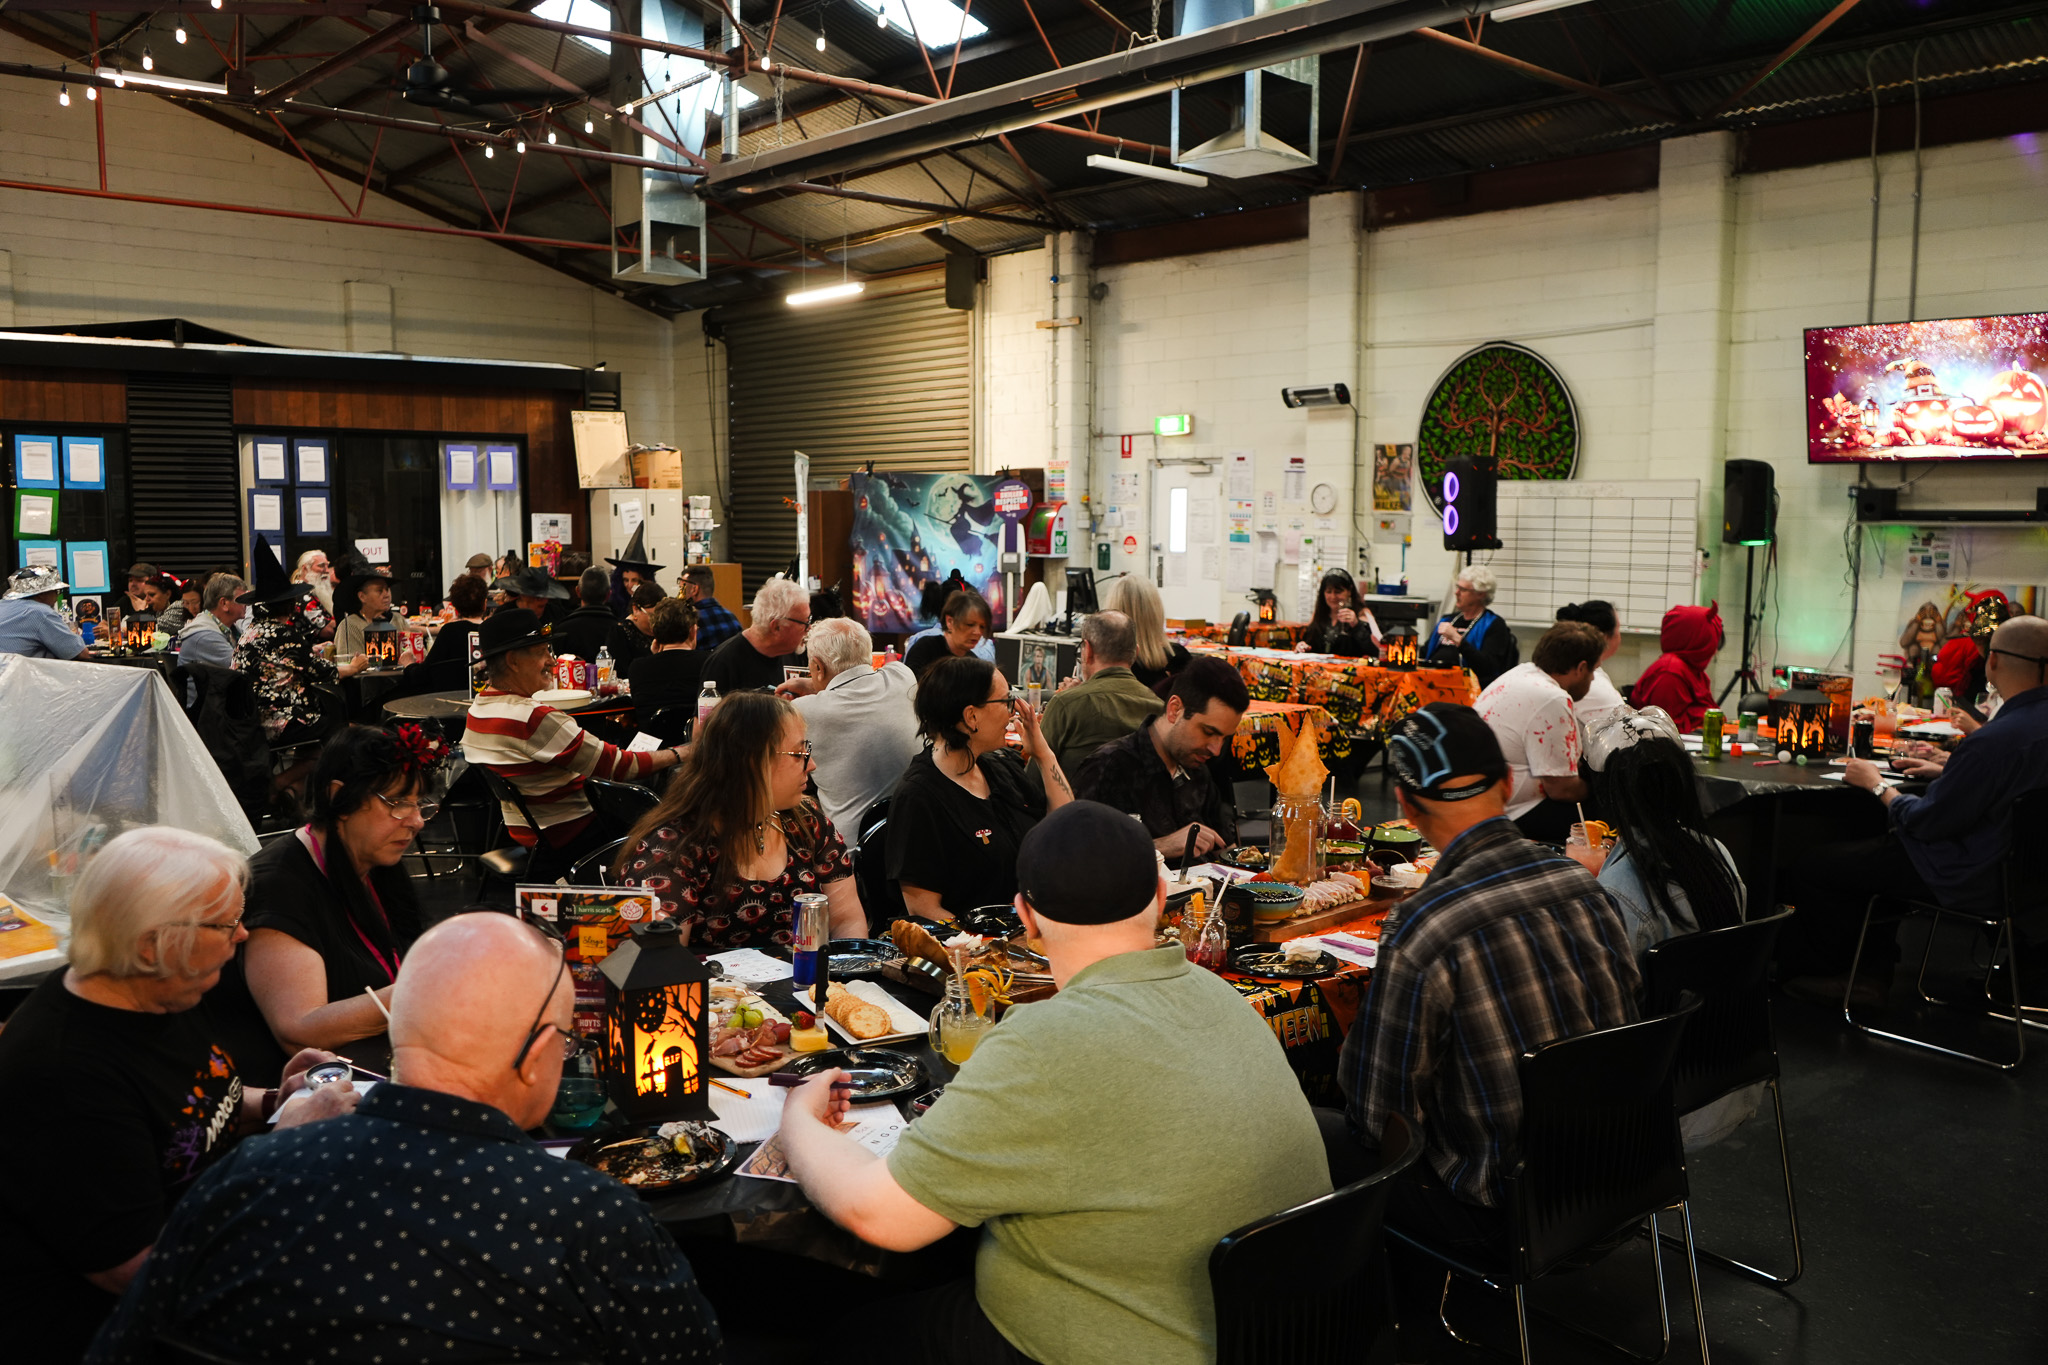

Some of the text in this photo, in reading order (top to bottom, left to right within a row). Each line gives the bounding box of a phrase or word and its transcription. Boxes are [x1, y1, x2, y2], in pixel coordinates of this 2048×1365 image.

[362, 547, 382, 556] OUT
[795, 935, 812, 946] Bull
[579, 1018, 601, 1027] HOYTS
